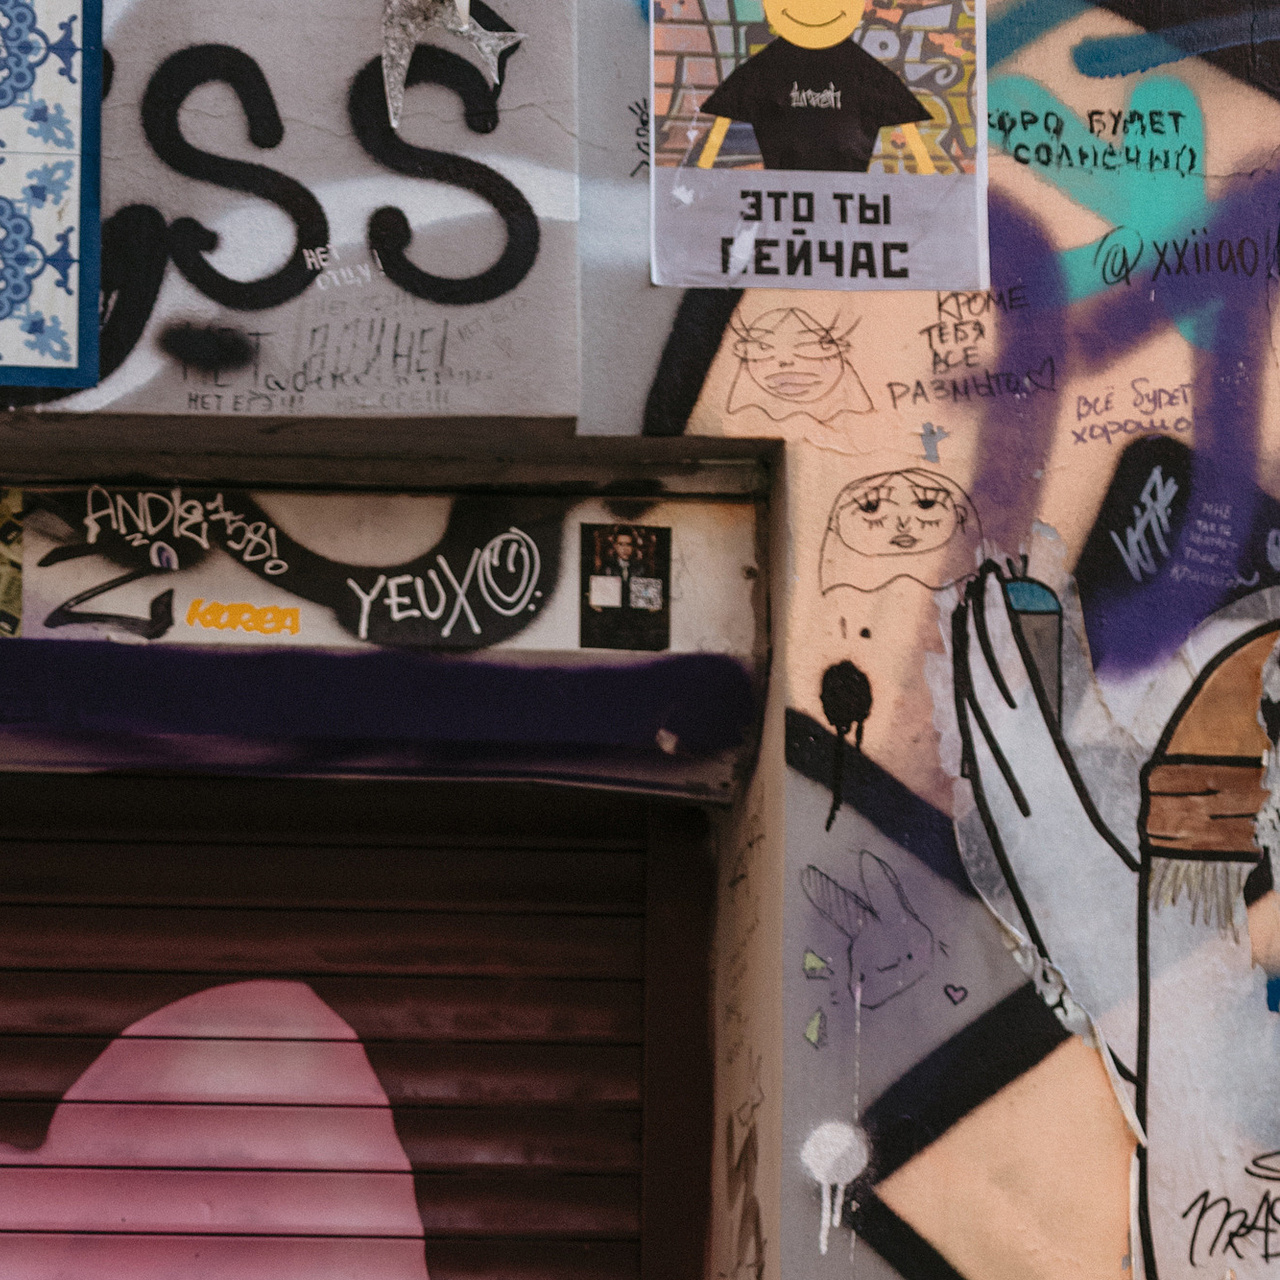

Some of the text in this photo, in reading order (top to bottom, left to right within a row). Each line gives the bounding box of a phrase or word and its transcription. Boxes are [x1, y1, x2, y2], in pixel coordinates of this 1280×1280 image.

[740, 189, 891, 225] ЭТО ТЫ
[936, 285, 1030, 322] КРОМЕ
[918, 319, 987, 351] ТЕБЯ
